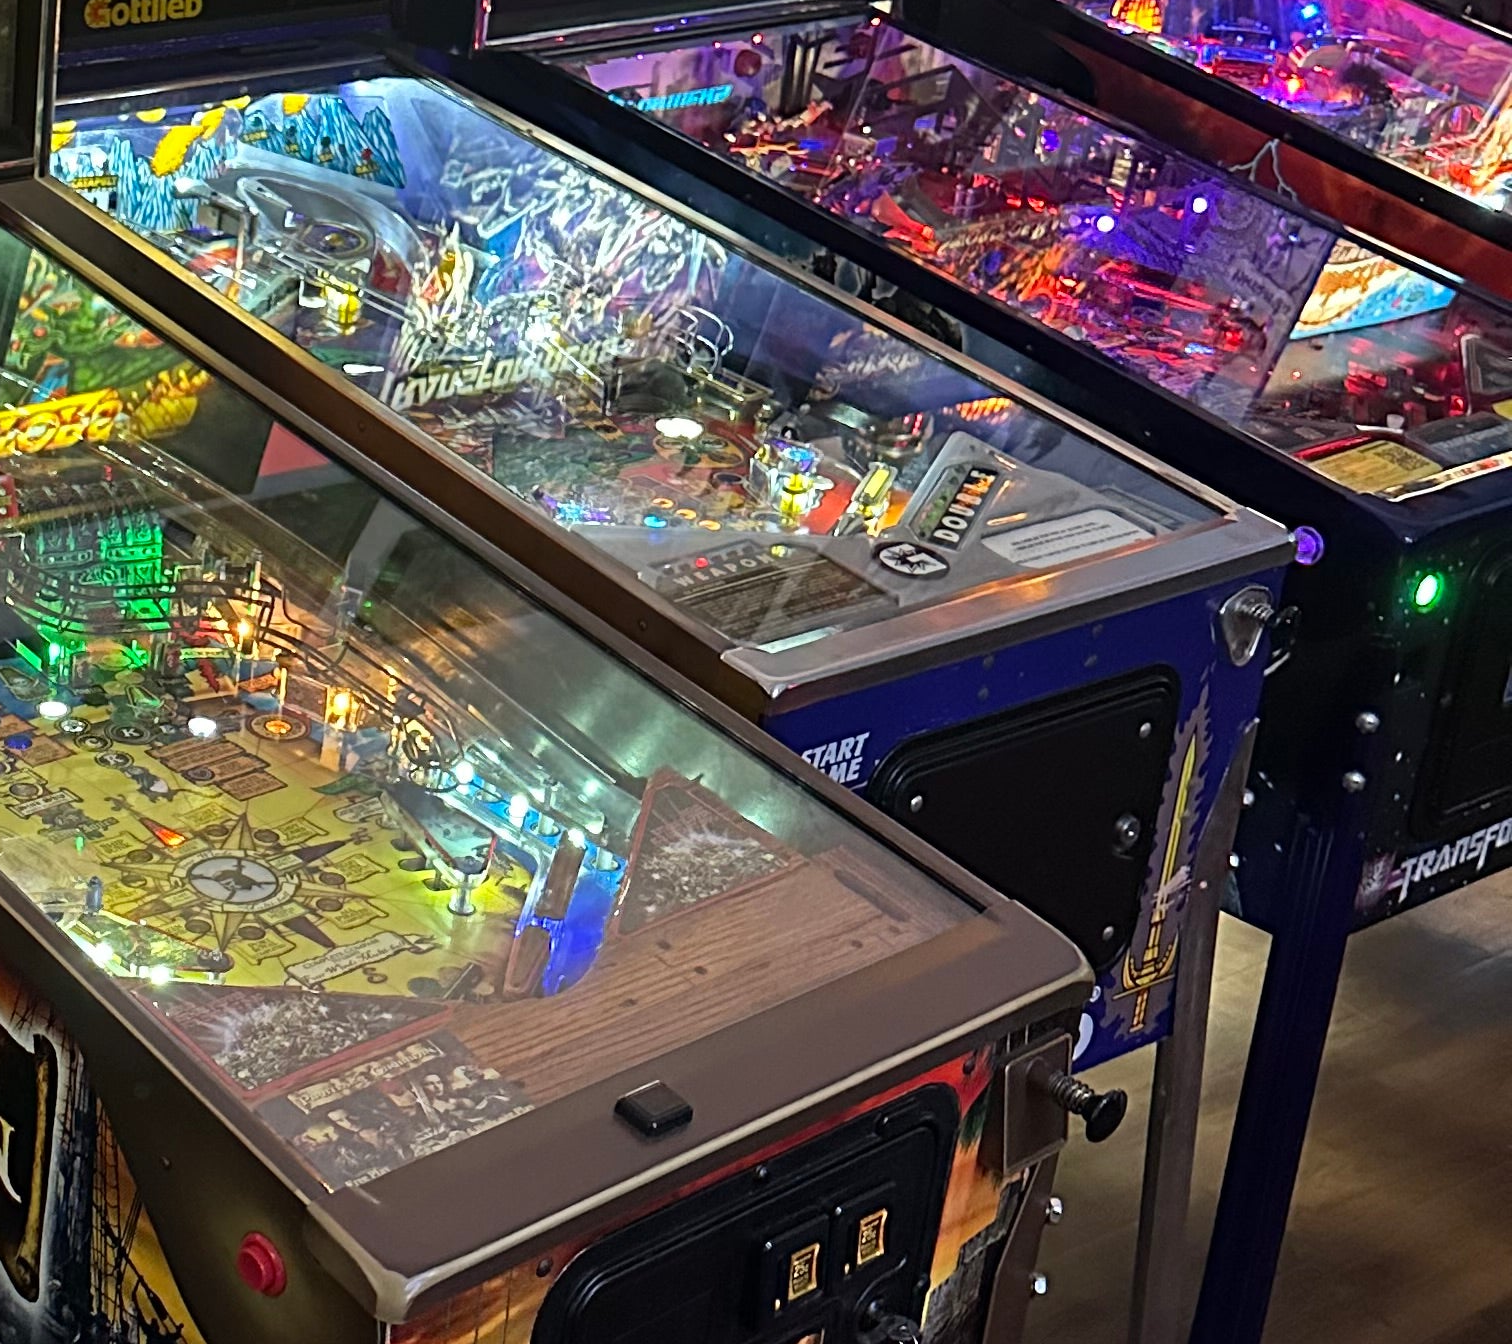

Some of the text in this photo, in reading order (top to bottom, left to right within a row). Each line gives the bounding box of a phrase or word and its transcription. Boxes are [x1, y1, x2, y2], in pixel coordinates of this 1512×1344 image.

[933, 467, 999, 545] DOUBLE
[801, 731, 870, 769] START
[819, 756, 864, 784] ME
